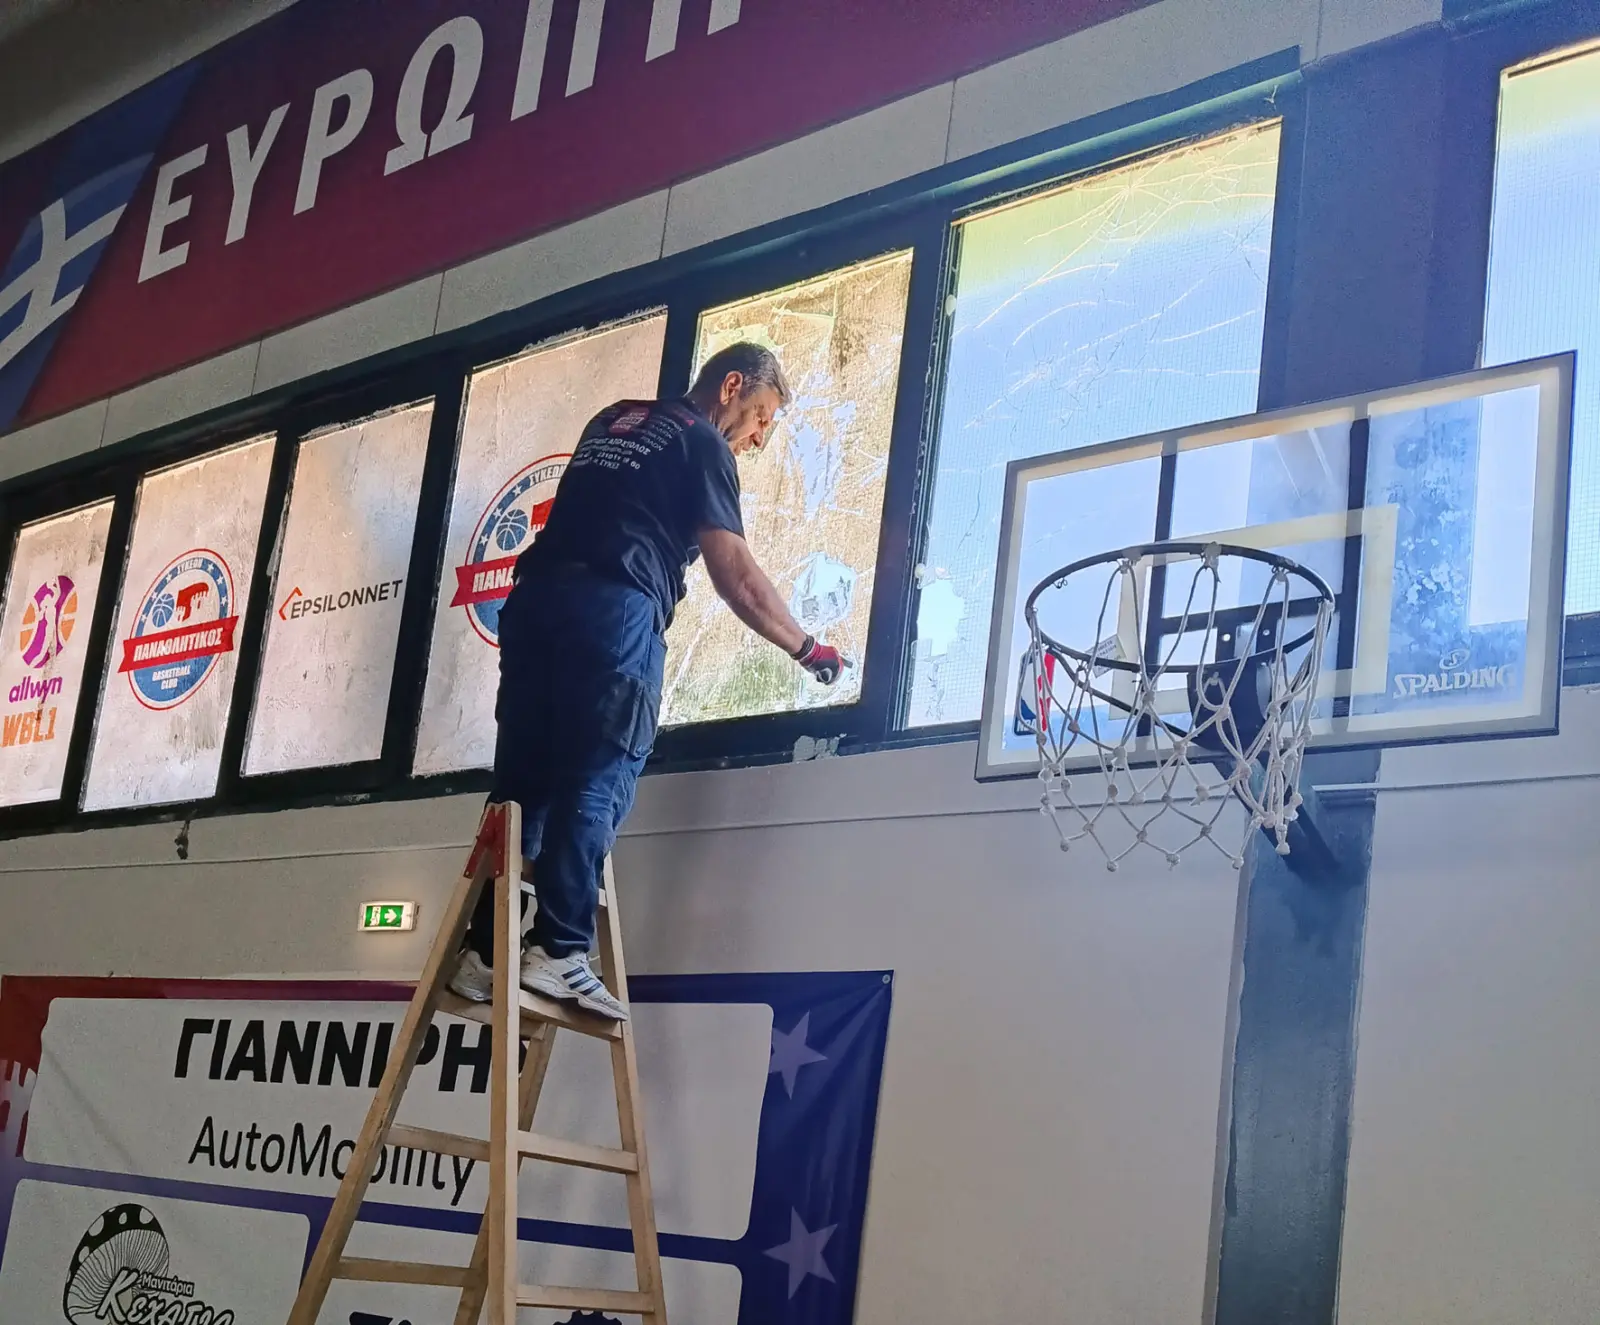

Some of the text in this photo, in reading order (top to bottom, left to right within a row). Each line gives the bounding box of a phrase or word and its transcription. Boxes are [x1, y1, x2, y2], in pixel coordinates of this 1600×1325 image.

[137, 0, 743, 284] ΕΥΡΩΠ
[133, 627, 224, 662] ΠΑΝΑΘΛΗΤΙΚΟΣ
[9, 675, 63, 703] allwyn
[152, 665, 191, 682] BASKETBALL
[161, 678, 178, 690] CLUB
[1393, 663, 1516, 699] SPALDING
[0, 707, 57, 748] WBL1
[141, 1272, 194, 1297] Μανιτάρια
